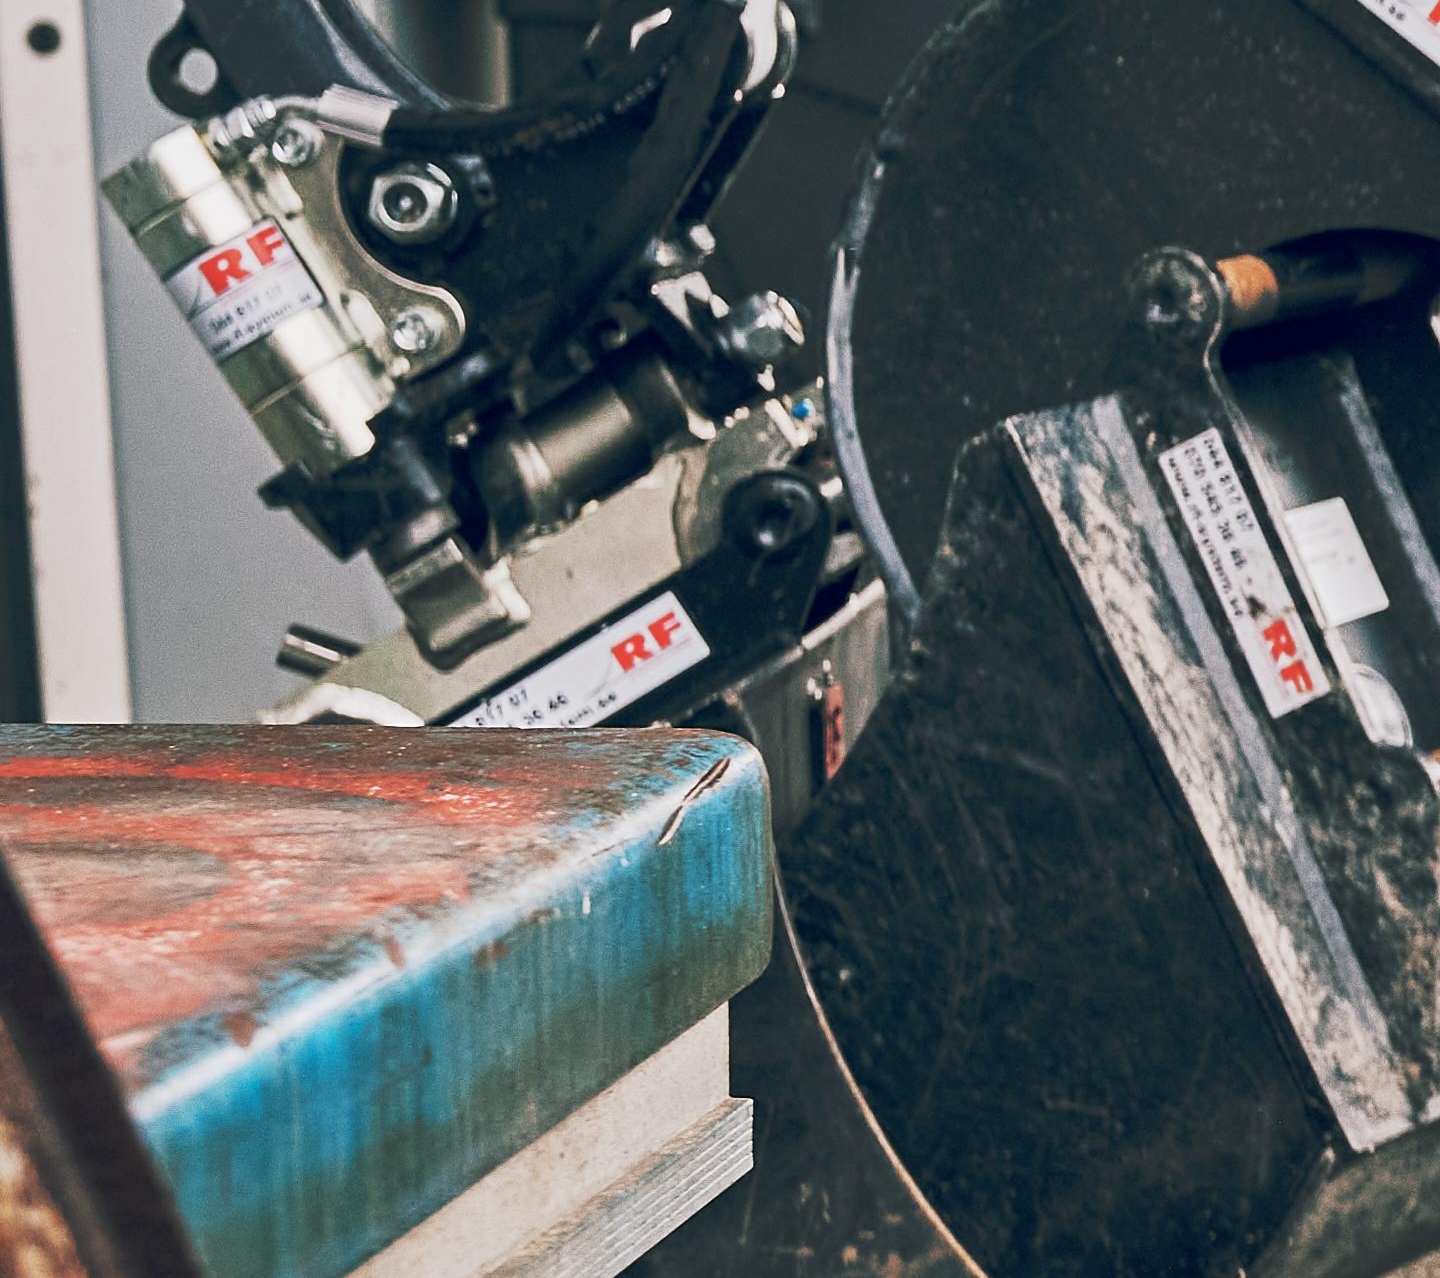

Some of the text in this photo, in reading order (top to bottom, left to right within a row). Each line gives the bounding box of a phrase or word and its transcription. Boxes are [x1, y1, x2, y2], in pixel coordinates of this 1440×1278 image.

[198, 225, 287, 296] RF
[610, 612, 682, 673] RF
[1263, 620, 1314, 693] RF
